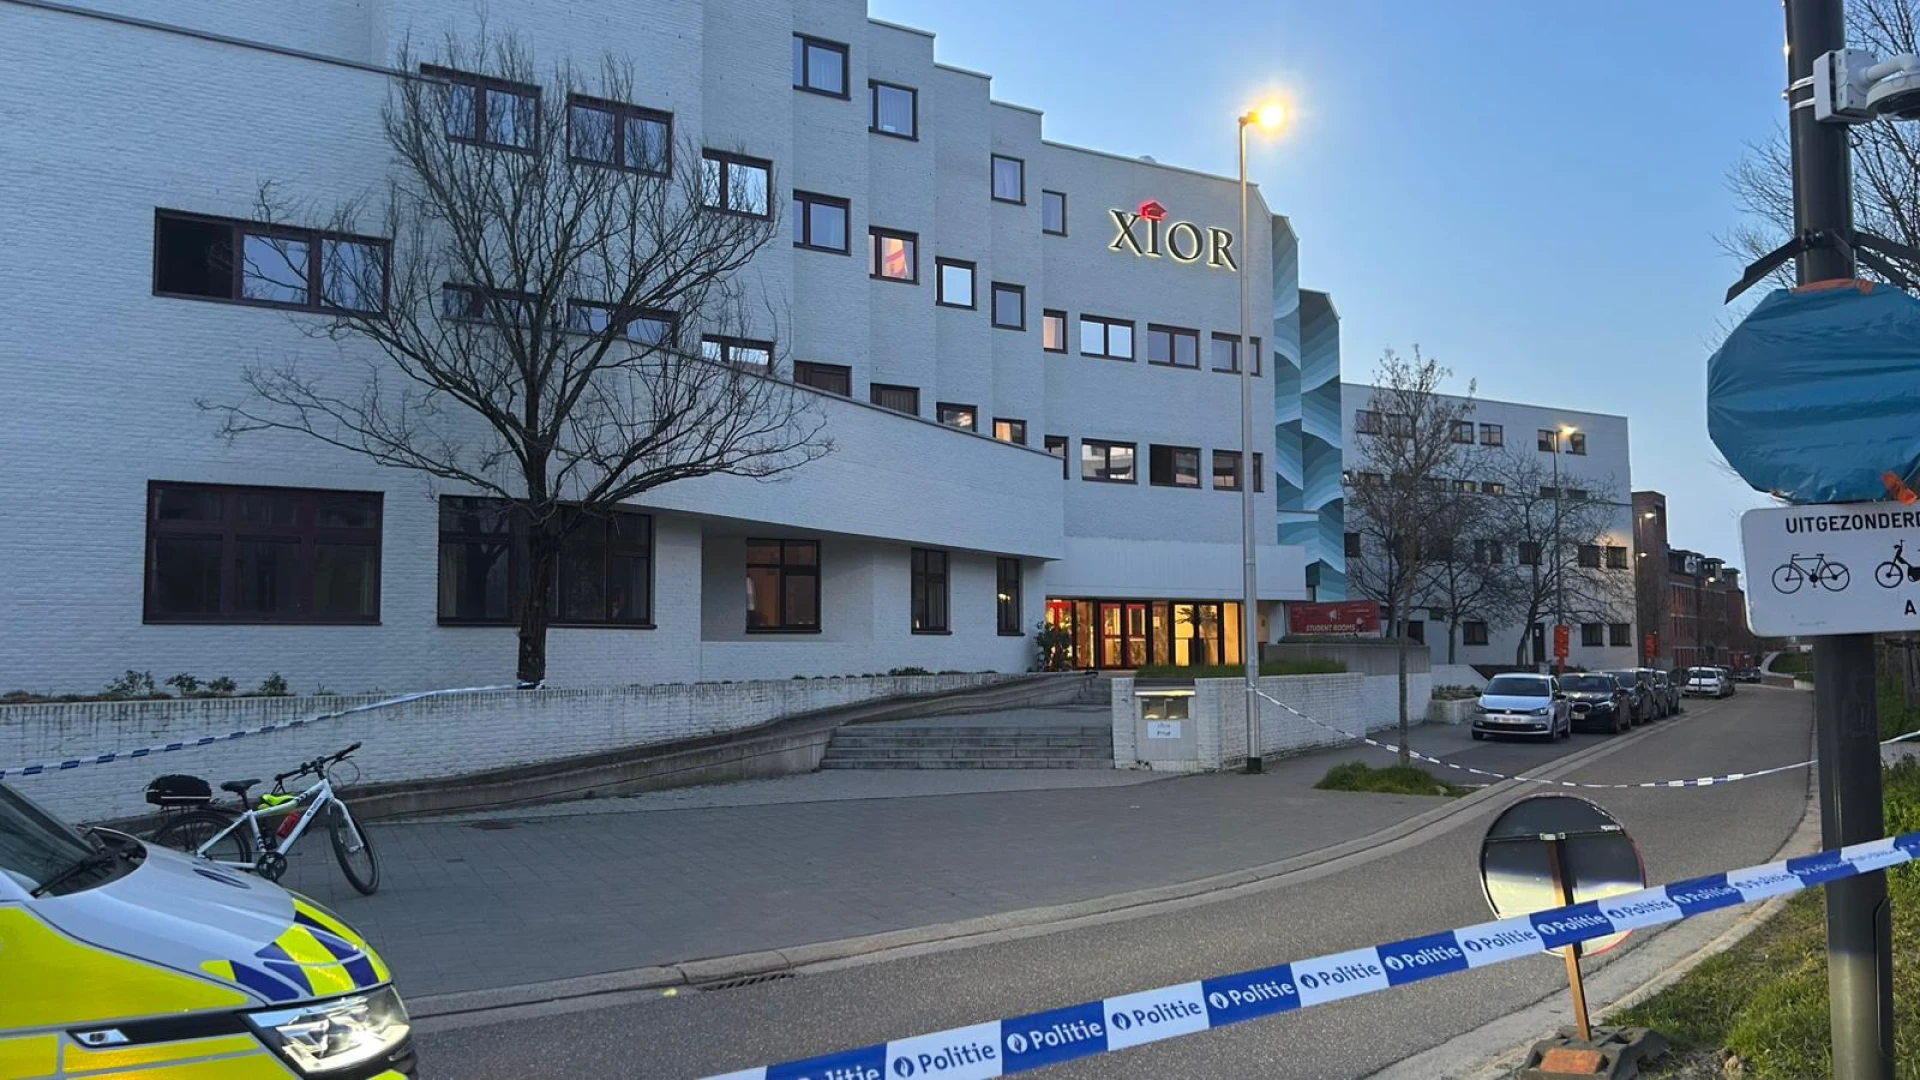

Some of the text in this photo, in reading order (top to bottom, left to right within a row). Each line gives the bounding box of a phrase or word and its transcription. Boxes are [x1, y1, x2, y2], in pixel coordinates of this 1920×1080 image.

[1109, 207, 1238, 270] XIOR
[917, 1042, 996, 1074] Politie
[1029, 1019, 1104, 1050] Politie
[1132, 1000, 1202, 1026] Politie
[1229, 980, 1295, 1006] Politie
[1321, 963, 1381, 986] Politie
[1403, 945, 1463, 968] Politie
[1482, 929, 1537, 950] Politie
[1557, 912, 1609, 933] Politie
[1623, 899, 1674, 918] Politie
